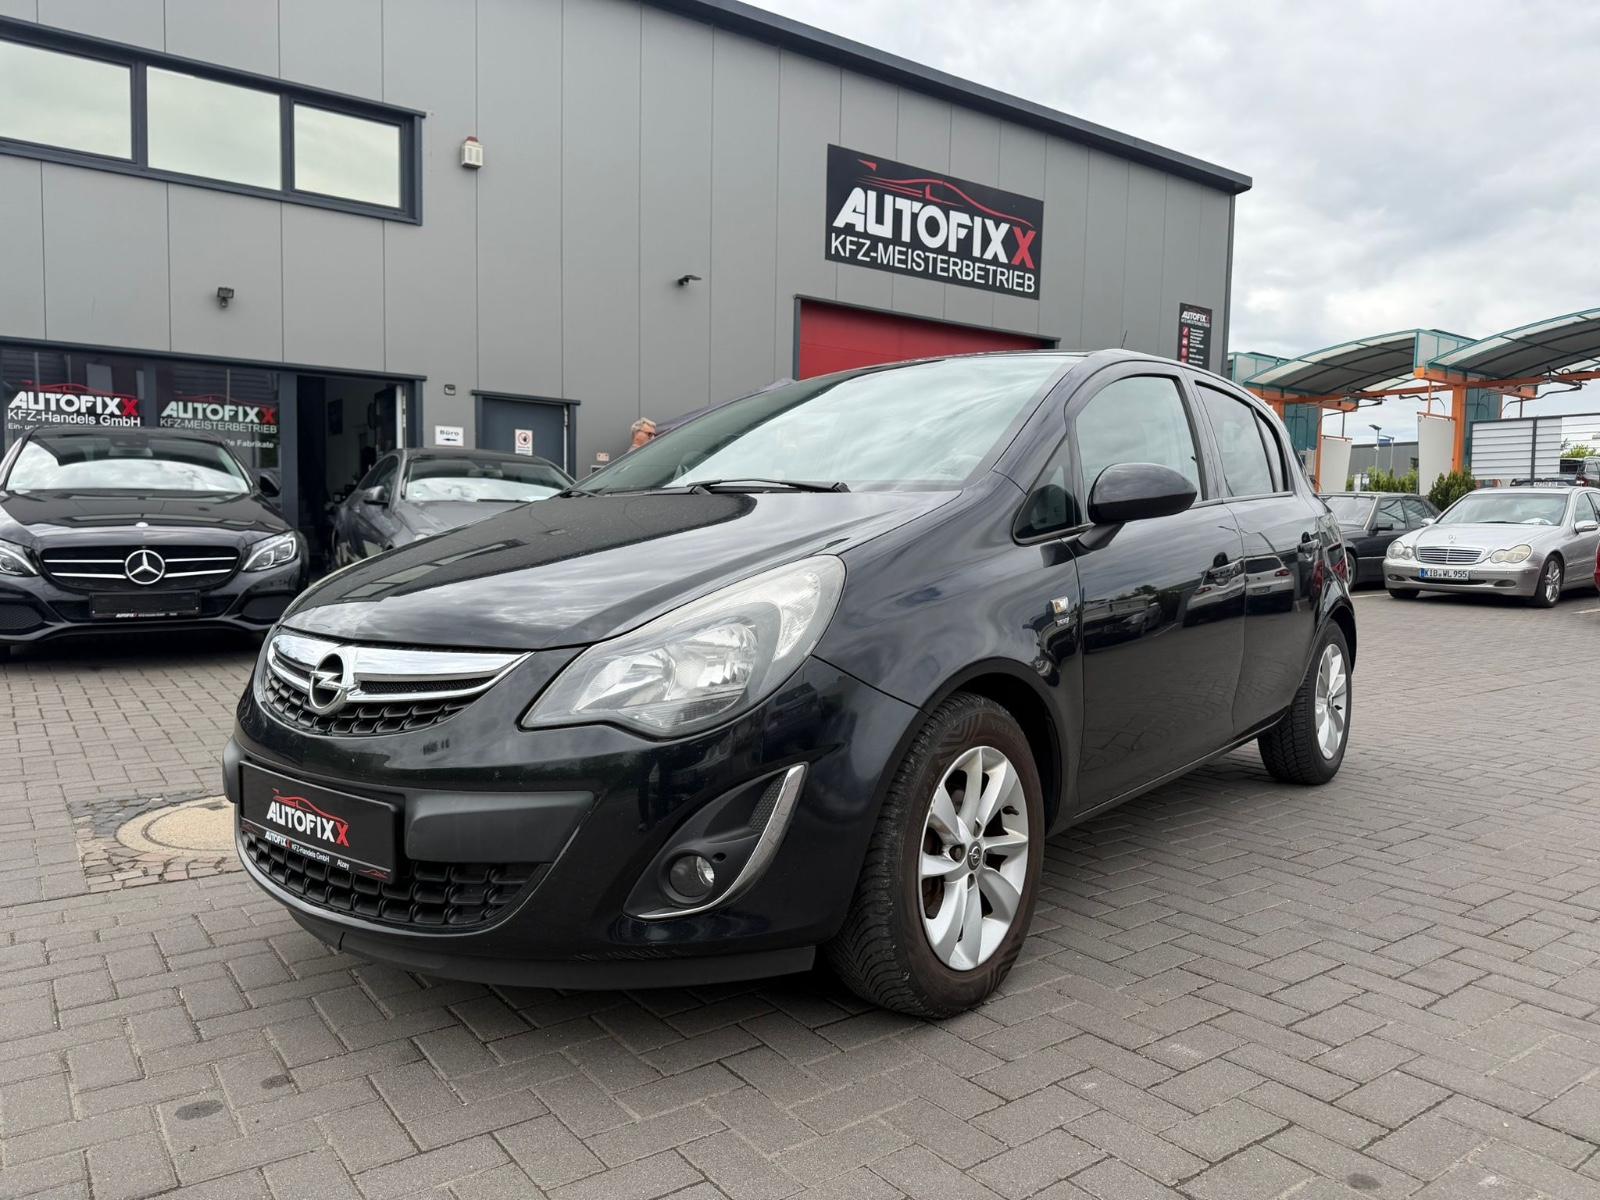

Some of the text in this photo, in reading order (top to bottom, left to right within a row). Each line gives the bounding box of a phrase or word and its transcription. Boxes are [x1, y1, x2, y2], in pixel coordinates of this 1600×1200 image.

[832, 187, 1037, 270] AUTOFIXX
[831, 233, 1035, 293] KFZ-MEISTERBETRIEB
[8, 391, 138, 416] AUTOFIXX
[160, 401, 277, 424] AUTOFIXX
[7, 409, 140, 427] KFZ-Handels GmbH
[160, 418, 277, 434] KFZ-MEISTERBETRIEB
[440, 429, 460, 437] Büro
[1453, 570, 1467, 578] 955
[266, 801, 350, 848] AUTOFIXX
[316, 852, 330, 863] GmbH
